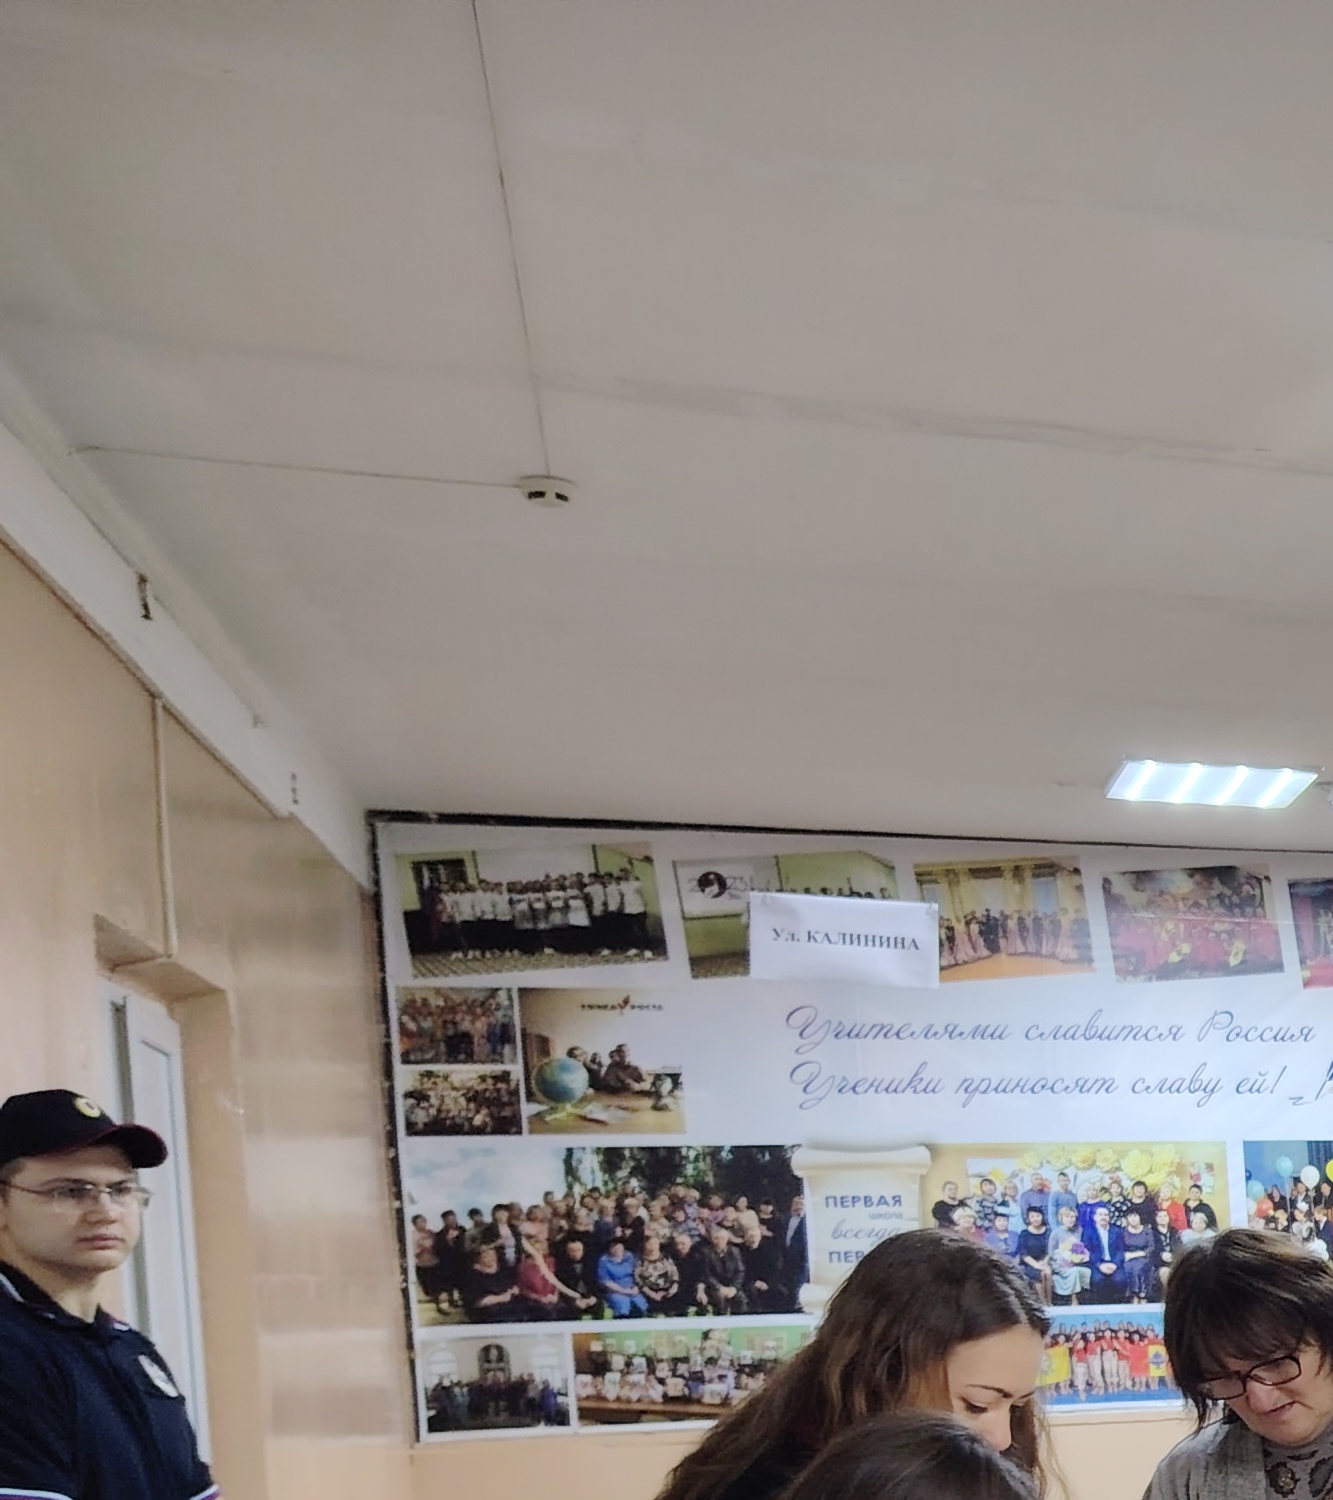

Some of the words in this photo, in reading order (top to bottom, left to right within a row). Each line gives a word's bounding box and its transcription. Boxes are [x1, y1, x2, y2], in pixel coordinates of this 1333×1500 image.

[806, 930, 920, 950] КАЛИНИНА
[785, 1005, 1012, 1055] Учителями
[1024, 1008, 1186, 1042] славится
[1196, 1010, 1318, 1042] Россия
[789, 1060, 945, 1110] Ученики
[954, 1074, 1119, 1108] приносят
[1131, 1062, 1224, 1107] славу
[1235, 1065, 1288, 1094] ей!
[825, 1195, 902, 1208] ПЕРВАЯ
